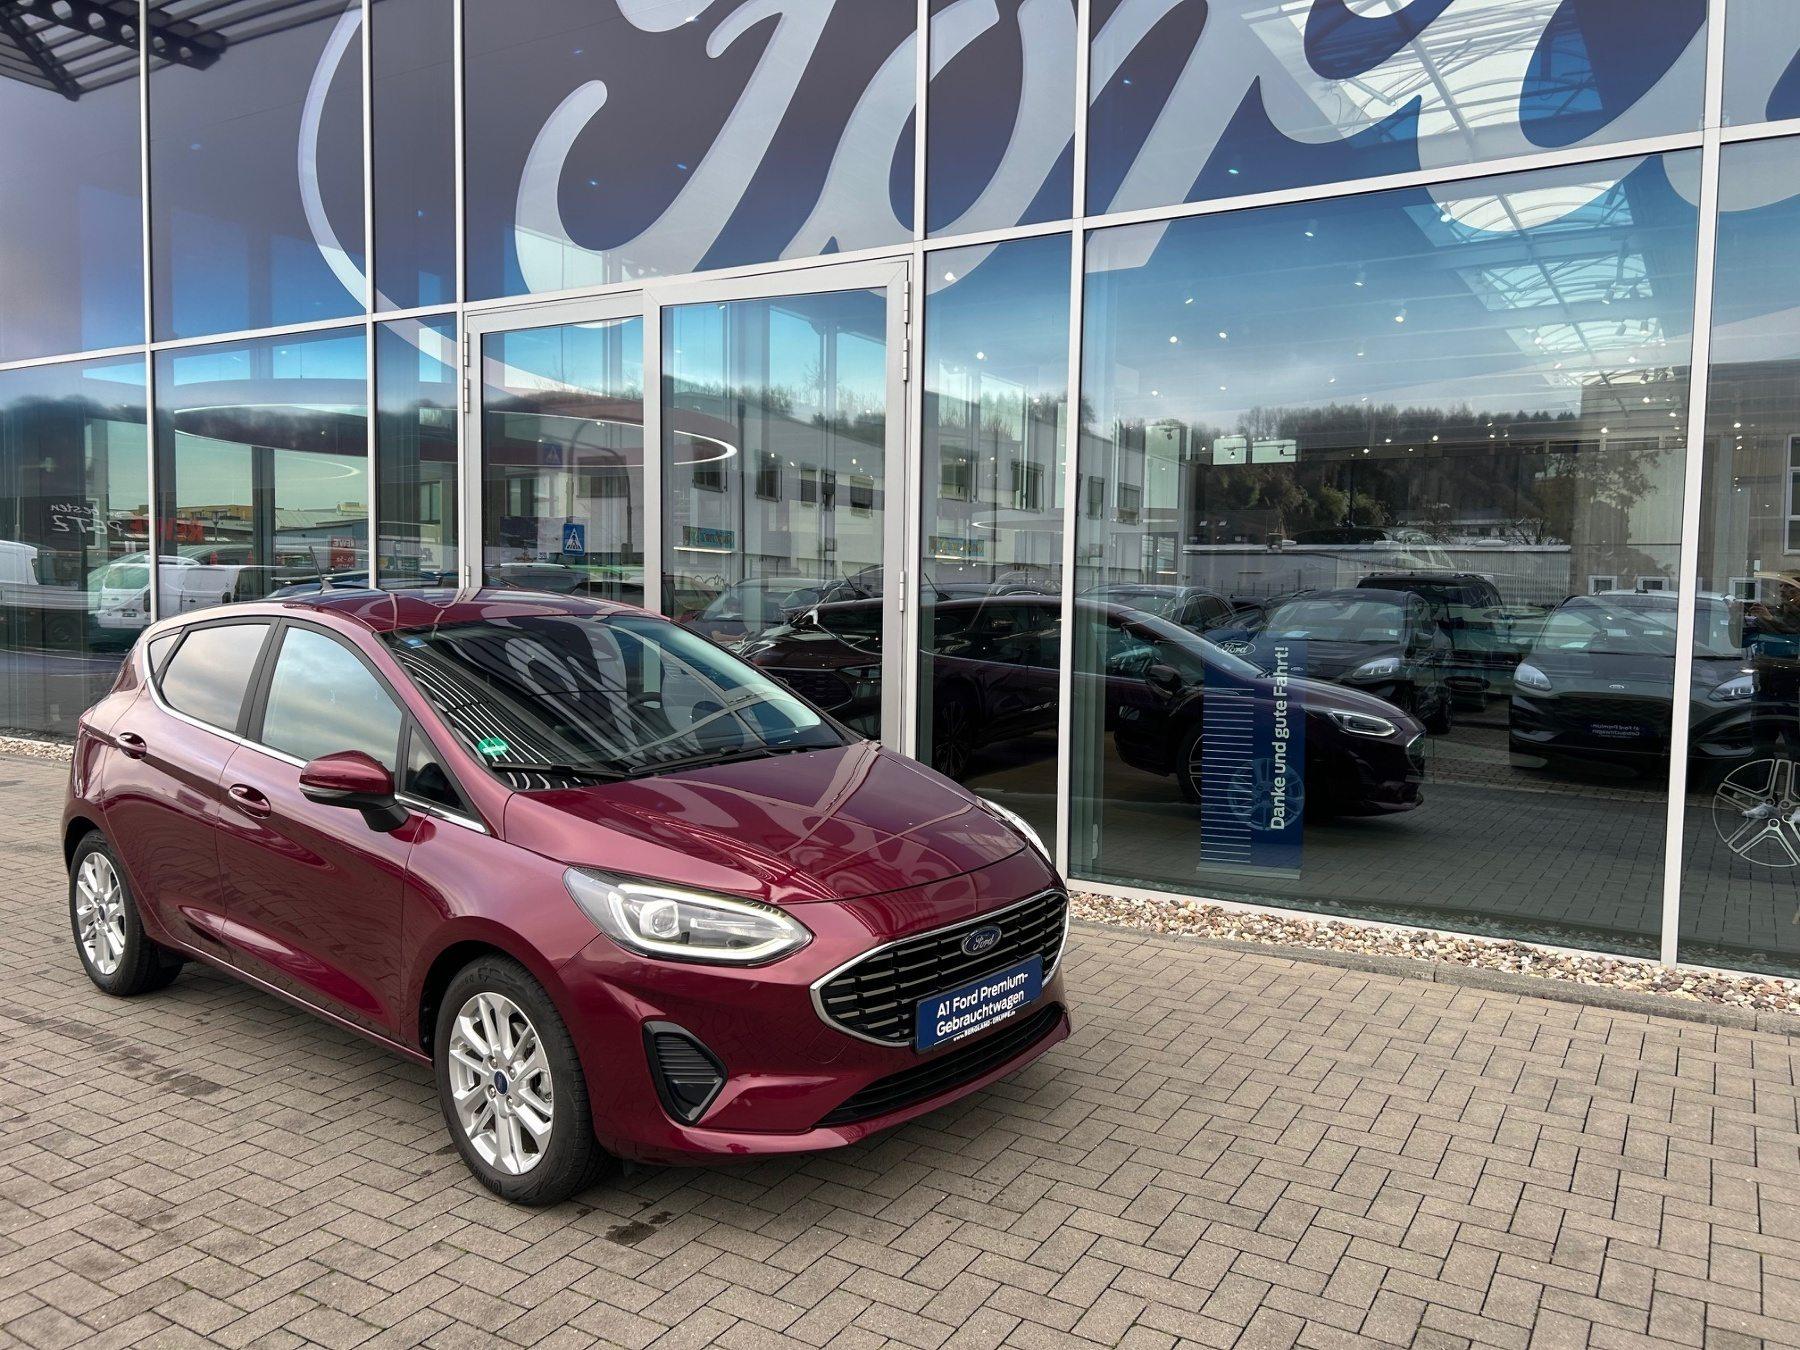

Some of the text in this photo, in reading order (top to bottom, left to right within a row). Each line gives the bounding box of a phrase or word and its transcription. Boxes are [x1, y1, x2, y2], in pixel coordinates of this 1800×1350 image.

[1221, 641, 1250, 656] Ford
[1270, 646, 1290, 830] Danke und gute Fahrt!
[972, 933, 995, 951] Ford
[936, 972, 1029, 1018] A1 Ford Premium-
[936, 990, 1025, 1036] Gebrauchtwagen
